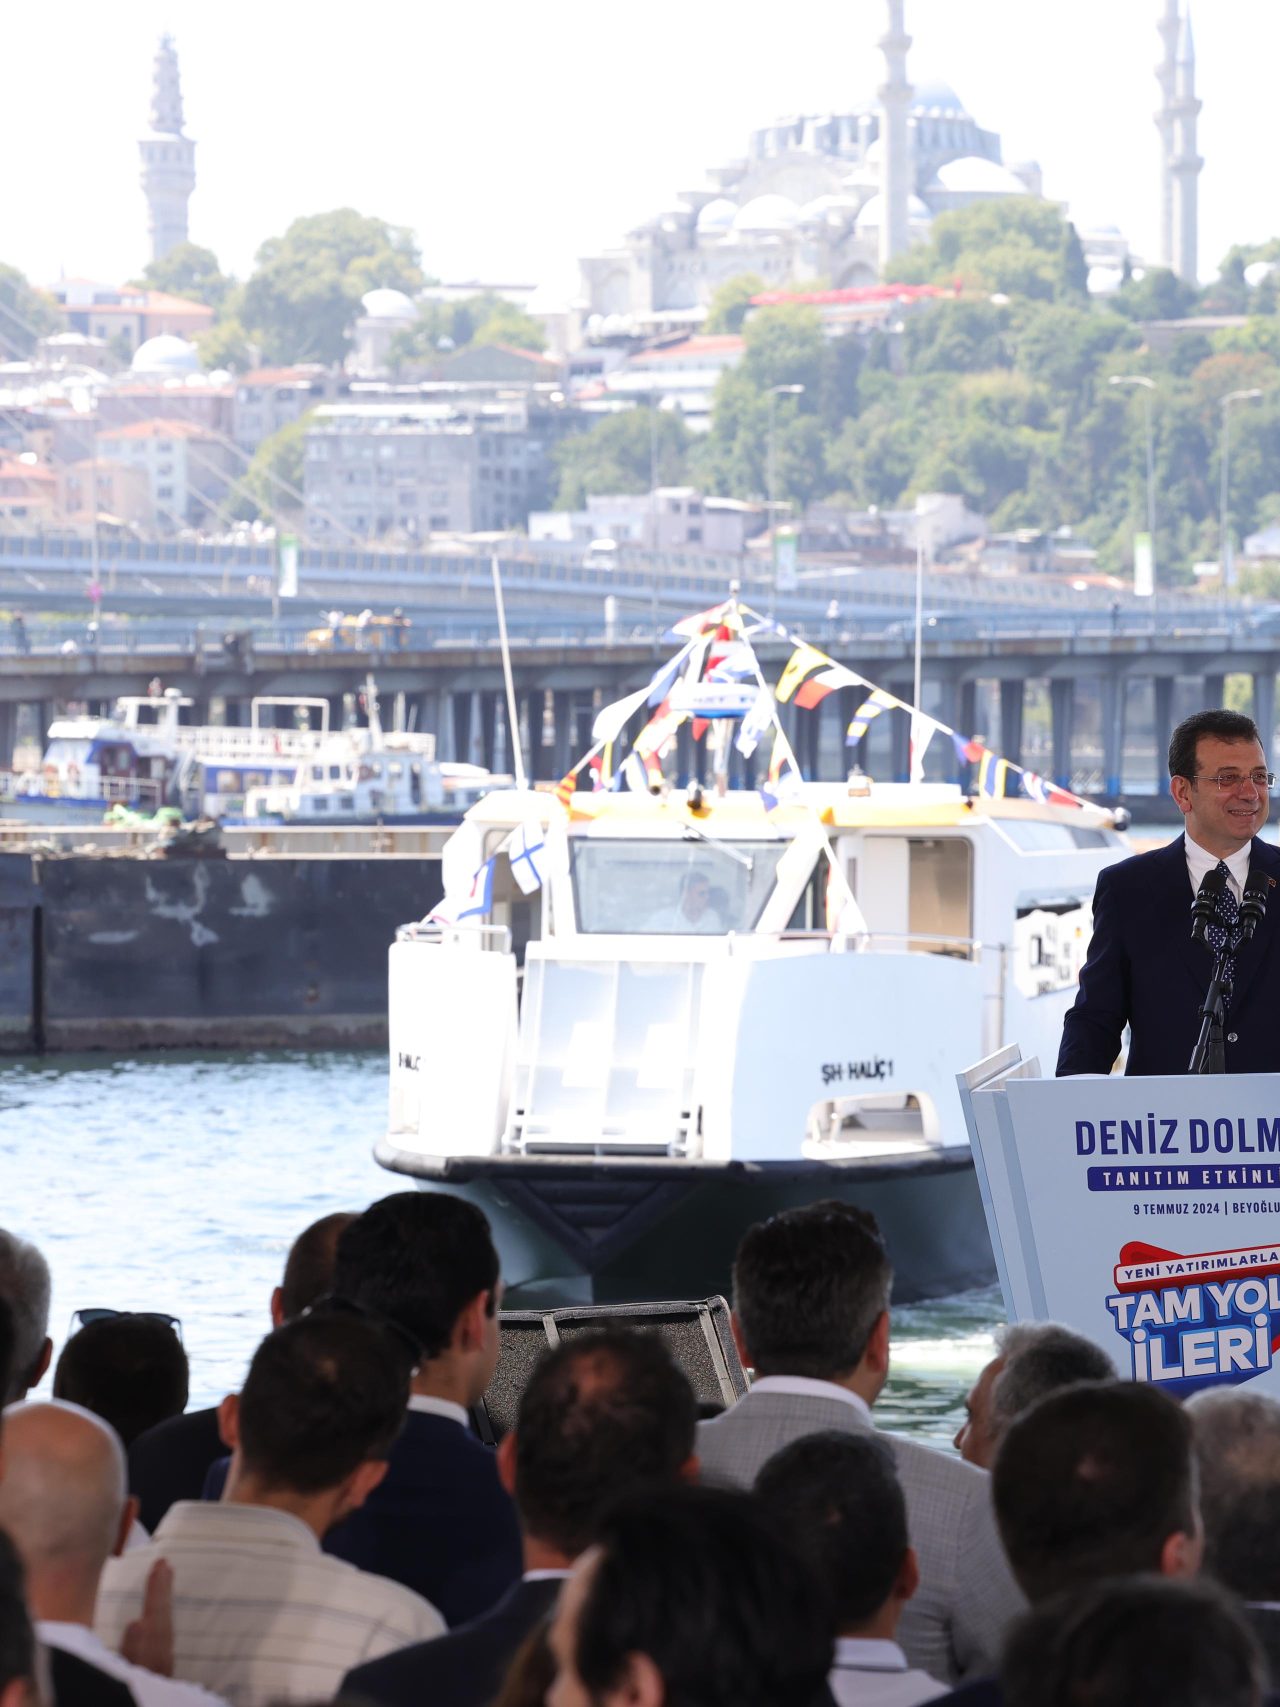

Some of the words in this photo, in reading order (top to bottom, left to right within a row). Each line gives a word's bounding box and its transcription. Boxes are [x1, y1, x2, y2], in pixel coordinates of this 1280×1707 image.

[1075, 1112, 1179, 1156] DENİZ
[1103, 1171, 1189, 1186] TANITIM
[1133, 1204, 1140, 1215] 9
[1143, 1203, 1189, 1215] TEMMUZ
[1192, 1202, 1220, 1215] 2024
[1232, 1200, 1280, 1214] BEYOĞLU
[1124, 1263, 1161, 1280] YENİ
[1165, 1251, 1280, 1275] YATIRIMLARLA
[1108, 1287, 1201, 1330] TAM
[1132, 1312, 1270, 1383] İLERİ
